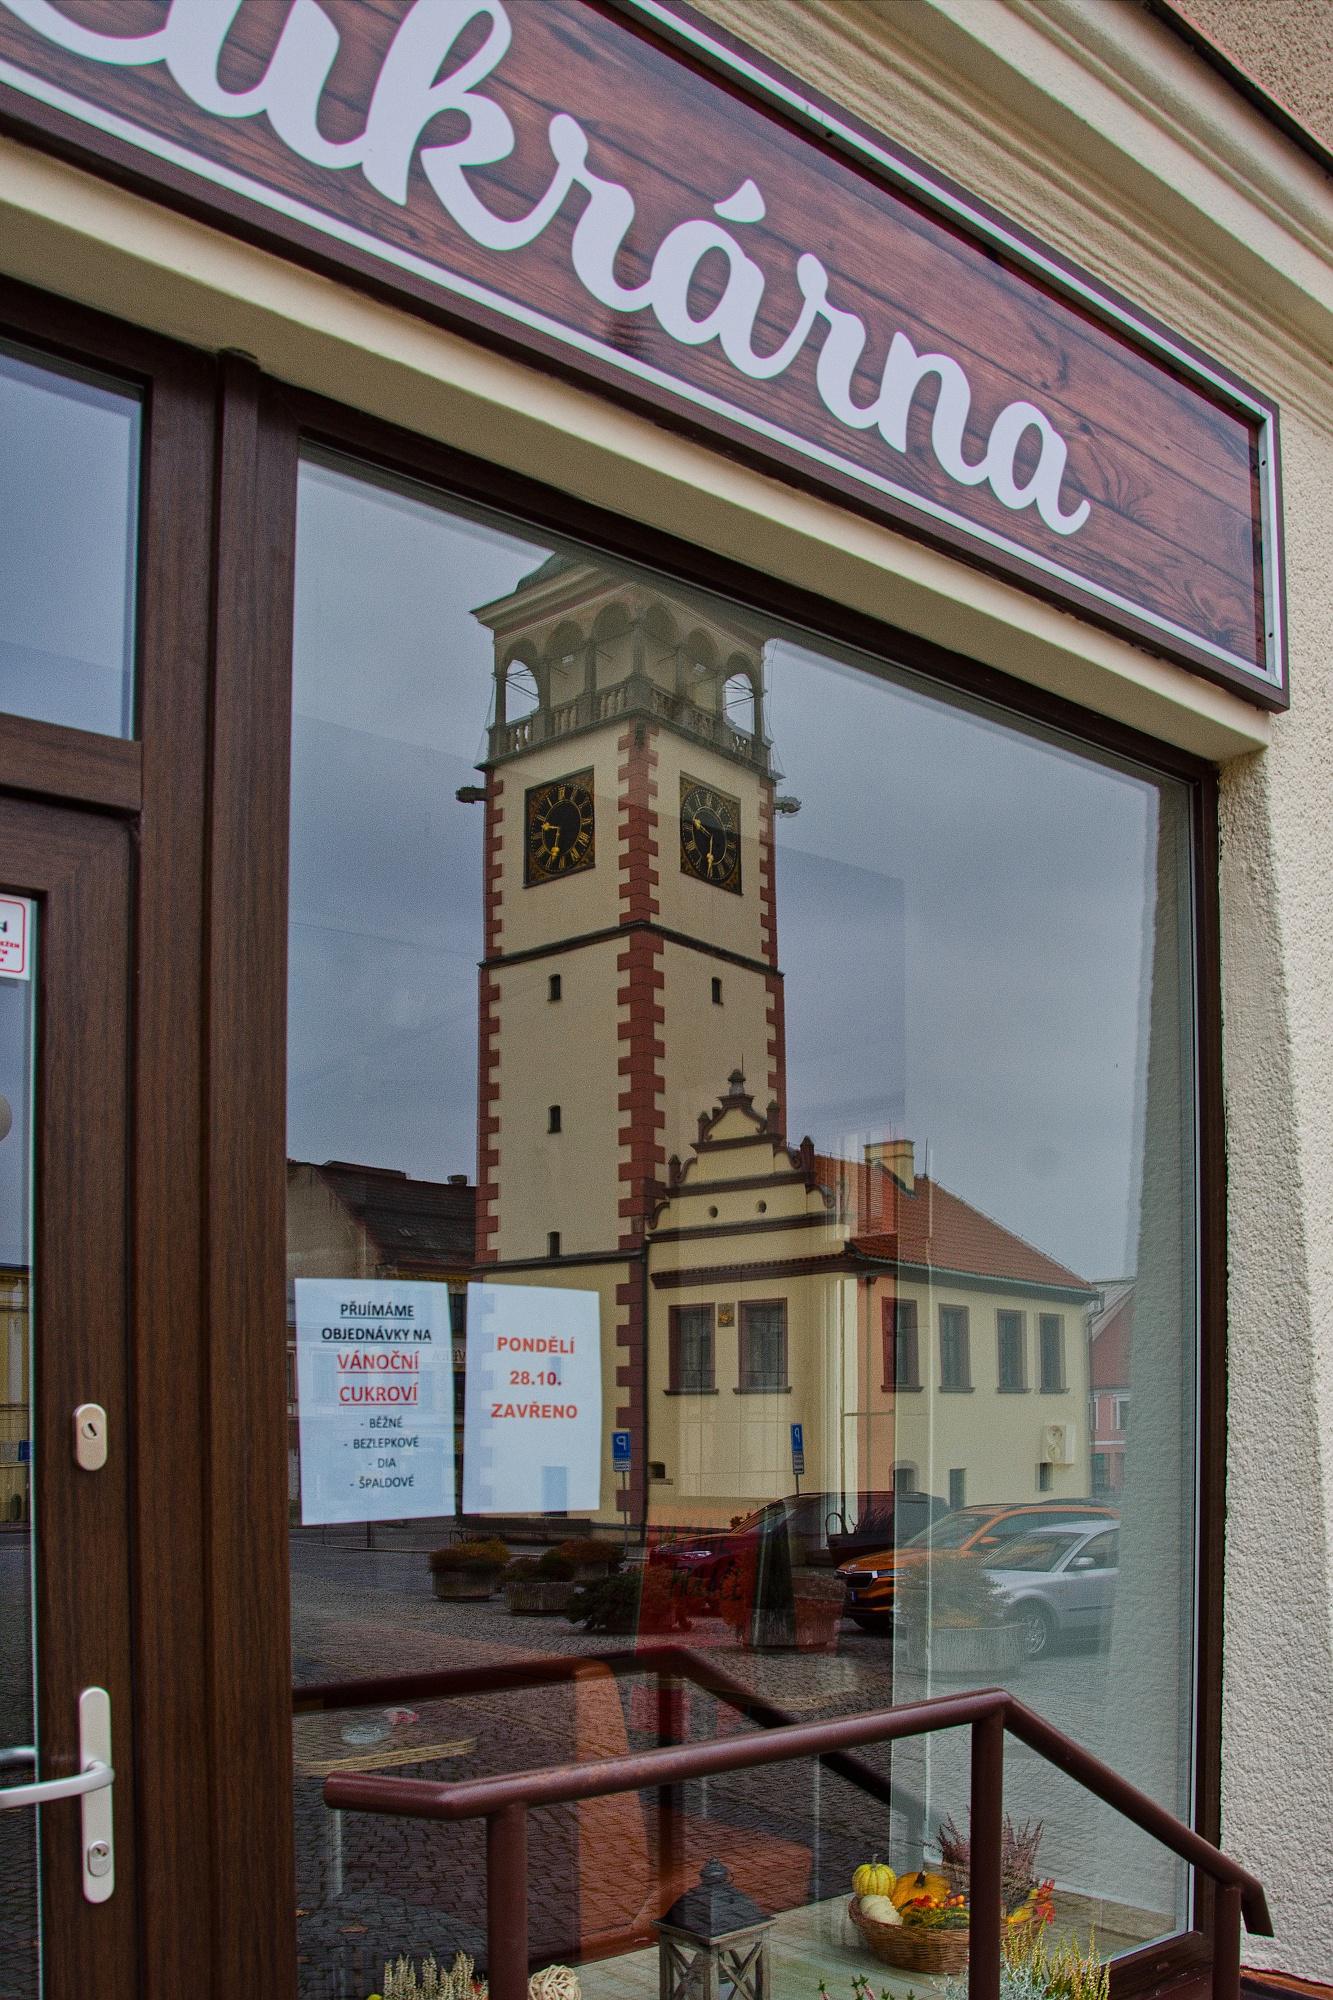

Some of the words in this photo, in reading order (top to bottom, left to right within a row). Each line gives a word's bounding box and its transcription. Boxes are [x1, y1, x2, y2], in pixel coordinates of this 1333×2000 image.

[340, 1301, 414, 1317] PŘIJÍMÁME
[321, 1326, 410, 1341] OBJEDNÁVKY
[413, 1329, 432, 1341] NA
[496, 1335, 575, 1355] PONDĚLÍ
[337, 1350, 420, 1370] VÁNOČNÍ
[509, 1370, 562, 1386] 28.10.
[339, 1382, 418, 1402] CUKROVÍ
[490, 1401, 579, 1419] ZAVŘENO
[353, 1434, 420, 1450] BEZLEPKOVÉ
[377, 1457, 397, 1469] DIA
[358, 1473, 415, 1490] ŠPALDOVÉ
